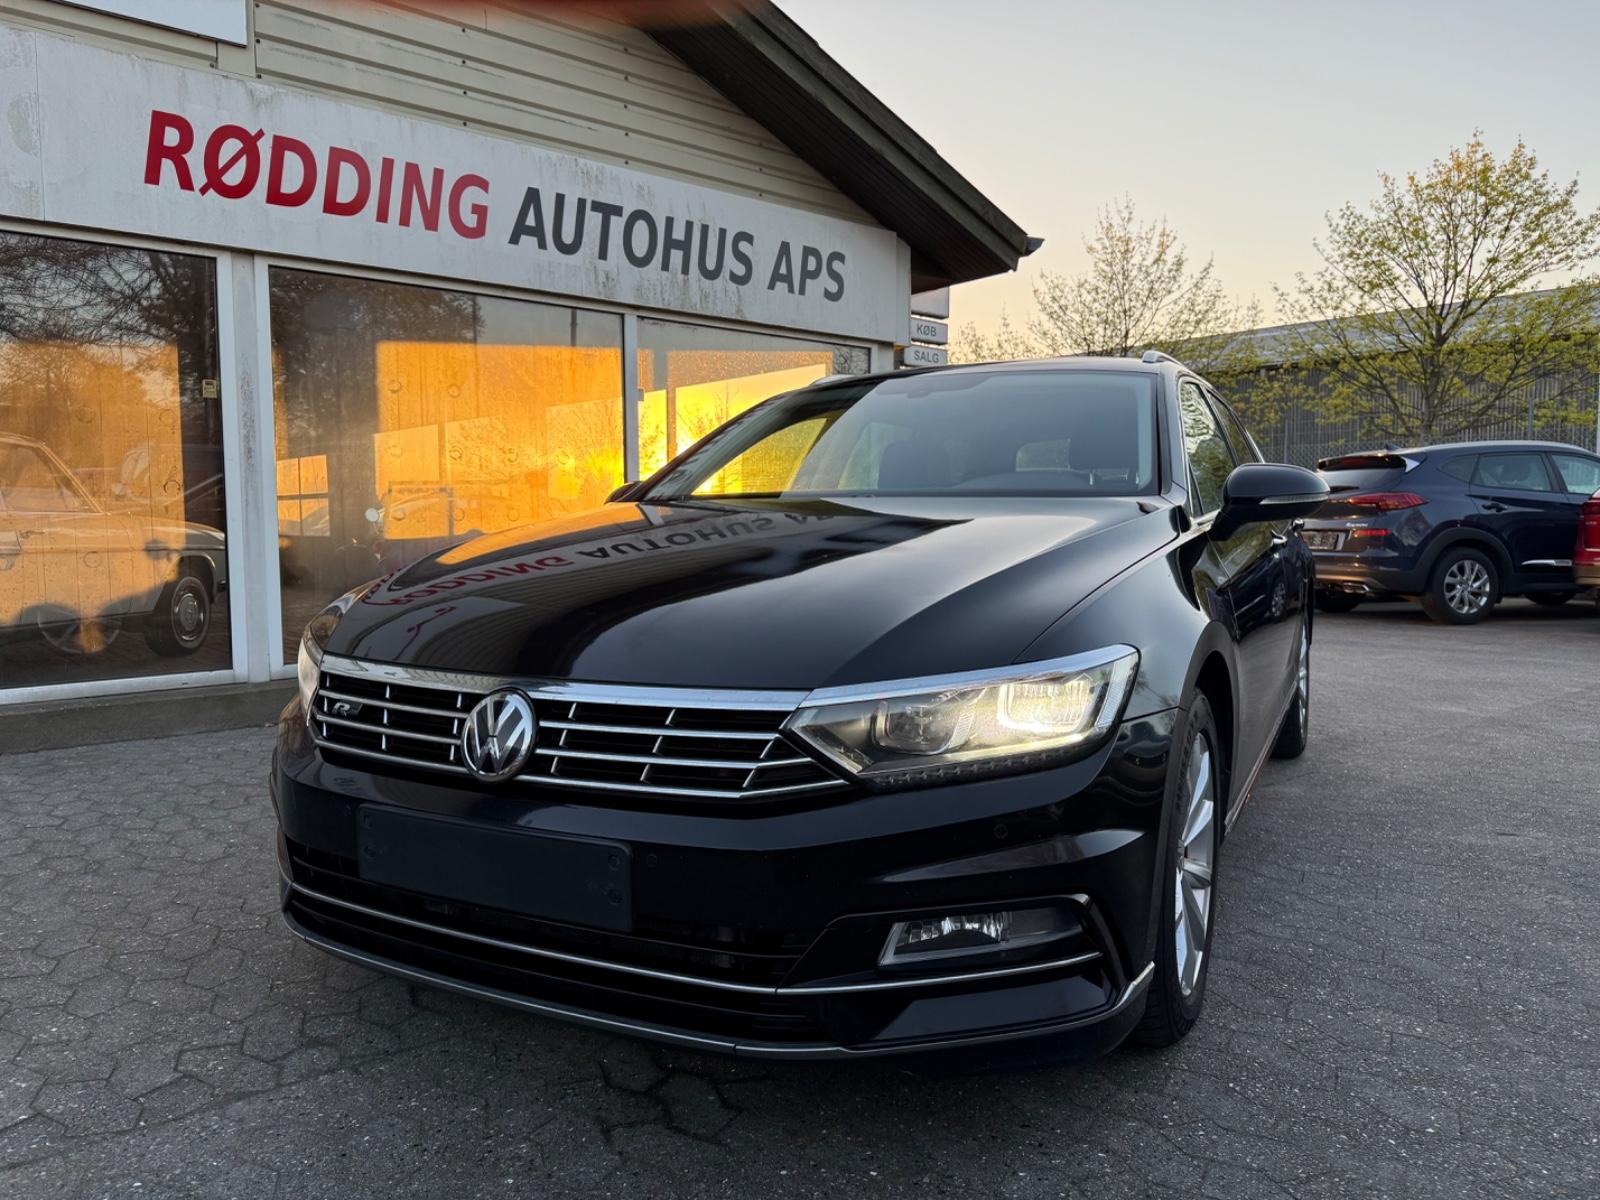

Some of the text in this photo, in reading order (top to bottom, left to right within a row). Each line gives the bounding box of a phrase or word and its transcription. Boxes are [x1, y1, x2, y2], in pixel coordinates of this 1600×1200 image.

[143, 109, 847, 303] RØDDING AUTOHUS APS
[916, 323, 937, 337] KØB
[914, 350, 939, 363] SALG
